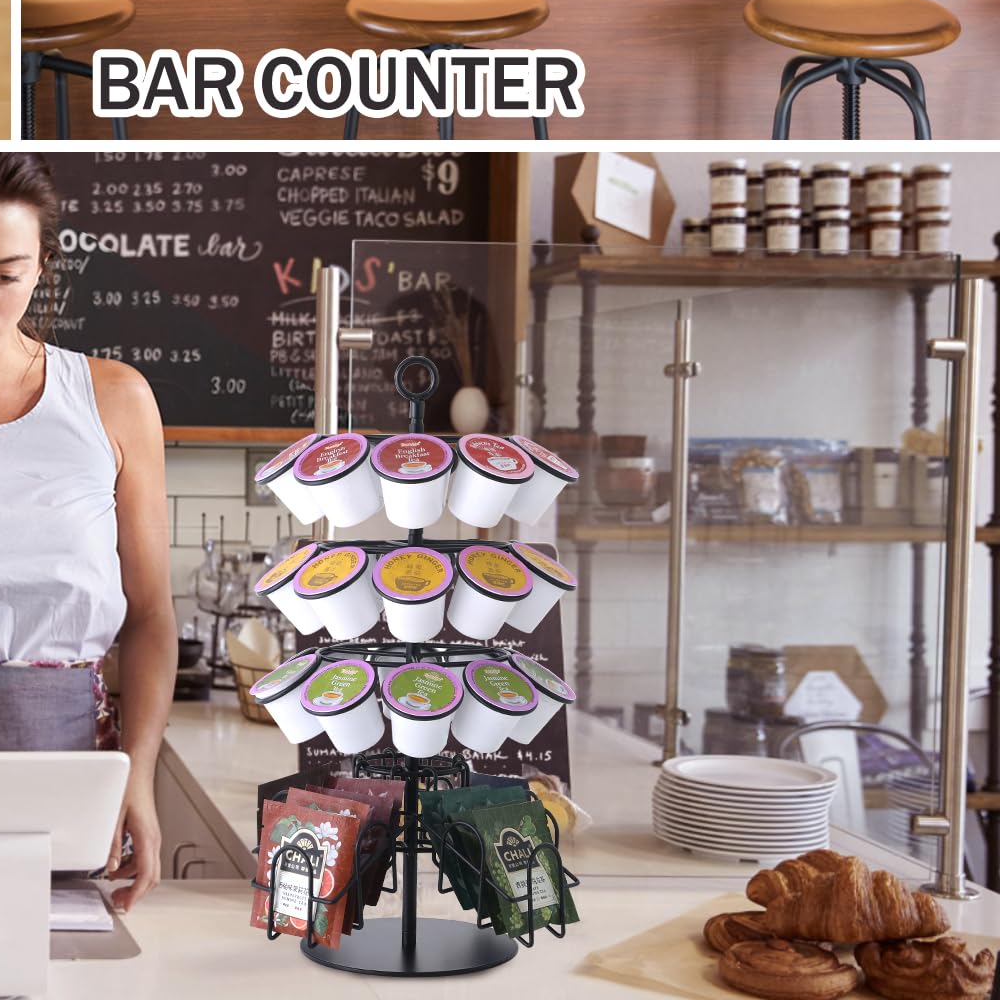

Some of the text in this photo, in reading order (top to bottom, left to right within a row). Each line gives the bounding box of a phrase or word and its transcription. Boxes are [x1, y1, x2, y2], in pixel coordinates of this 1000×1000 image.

[277, 166, 368, 183] CAPRESE
[421, 157, 460, 196] $9
[277, 186, 417, 206] CHOPPED ITALIAN
[280, 208, 464, 228] VEGGIE TACO SALAD
[58, 229, 263, 262] OCOLATE bar
[398, 270, 452, 293] BAR
[272, 330, 317, 349] BIRT
[374, 330, 424, 346] OAST
[210, 376, 246, 395] 3.00
[416, 554, 444, 574] GINGER
[412, 676, 443, 690] Jasmine
[414, 683, 436, 694] Green
[517, 750, 552, 761] $4.15
[503, 848, 532, 862] CHALI
